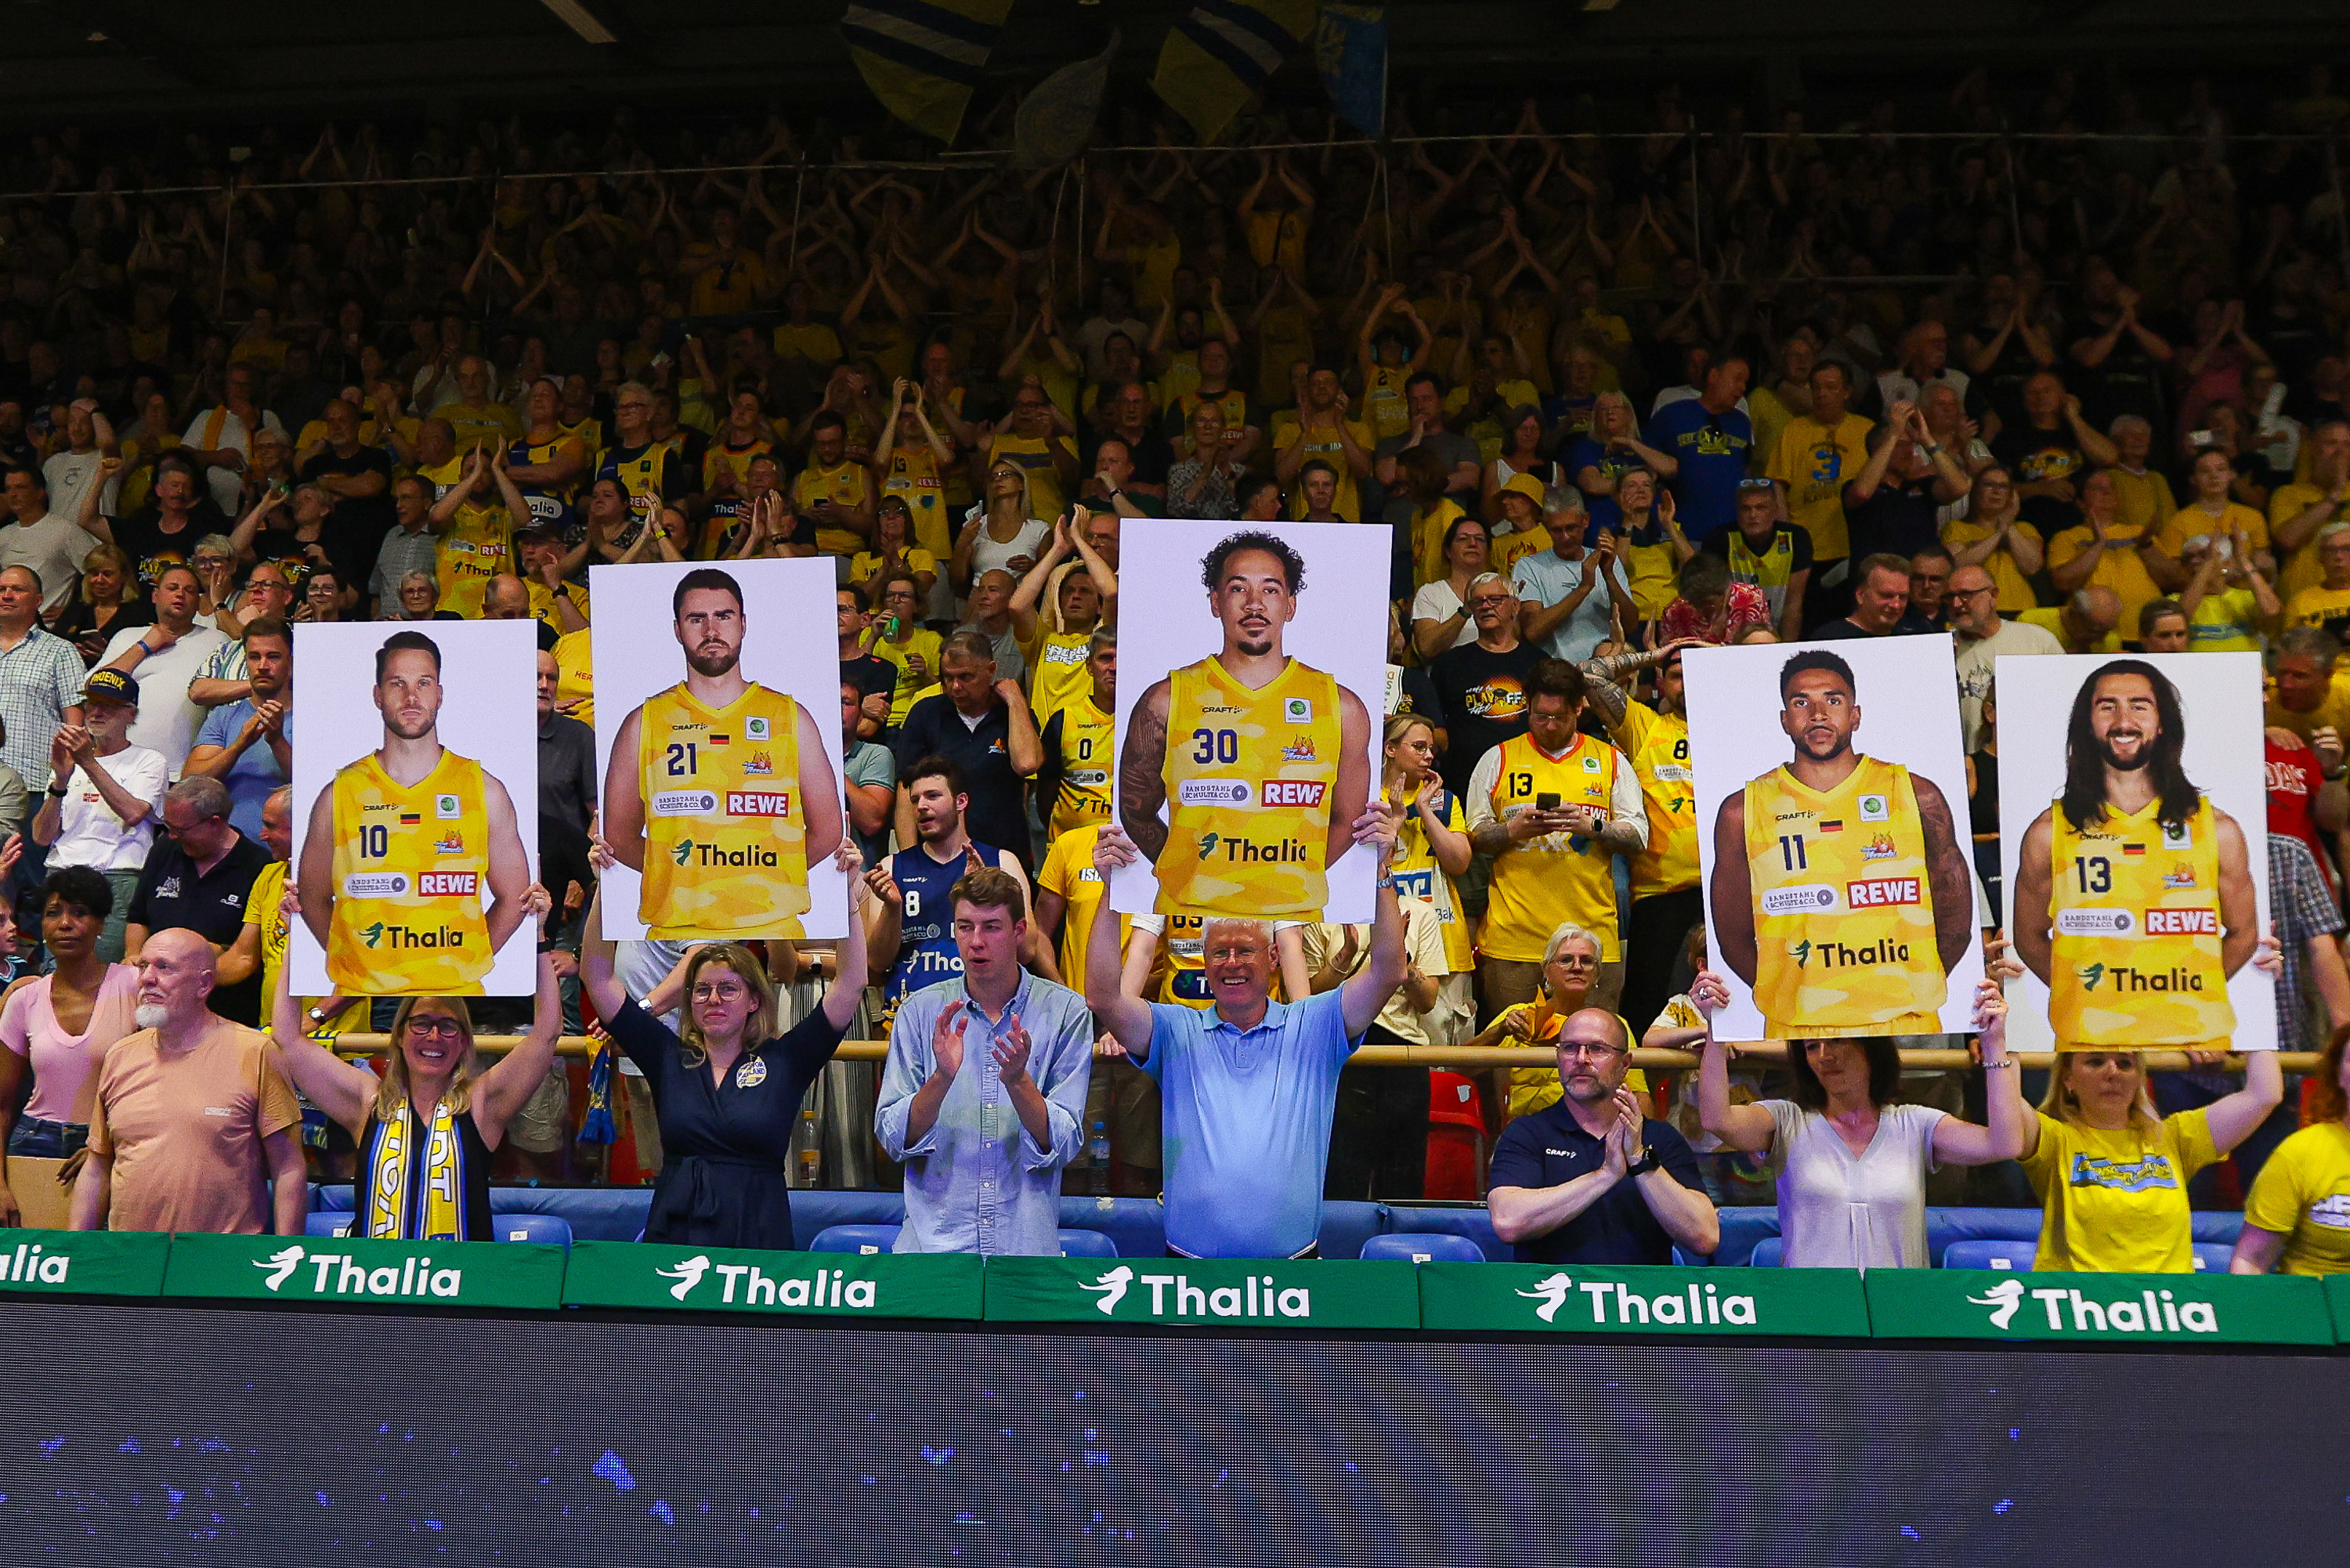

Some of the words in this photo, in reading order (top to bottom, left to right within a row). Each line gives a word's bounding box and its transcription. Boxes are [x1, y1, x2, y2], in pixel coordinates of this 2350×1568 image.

[667, 743, 697, 775] 21
[1079, 739, 1092, 760] 0
[1192, 728, 1238, 764] 30
[1509, 772, 1533, 798] 13
[728, 794, 786, 815] REWE
[1775, 811, 1806, 821] CRAFT
[359, 825, 387, 858] 10
[1779, 834, 1807, 871] 11
[696, 844, 777, 867] Thalia
[421, 874, 476, 894] REWE
[2075, 856, 2111, 893] 13
[906, 891, 920, 916] 8
[1849, 880, 1918, 905] REWE
[2148, 912, 2216, 931] REWE
[387, 925, 464, 948] Thalia
[1546, 1148, 1571, 1157] CRAFT
[309, 1255, 462, 1298] Thalia
[716, 1264, 877, 1309] Thalia
[1141, 1274, 1312, 1319] Thalia
[1579, 1281, 1757, 1326] Thalia
[2031, 1289, 2219, 1333] Thalia
